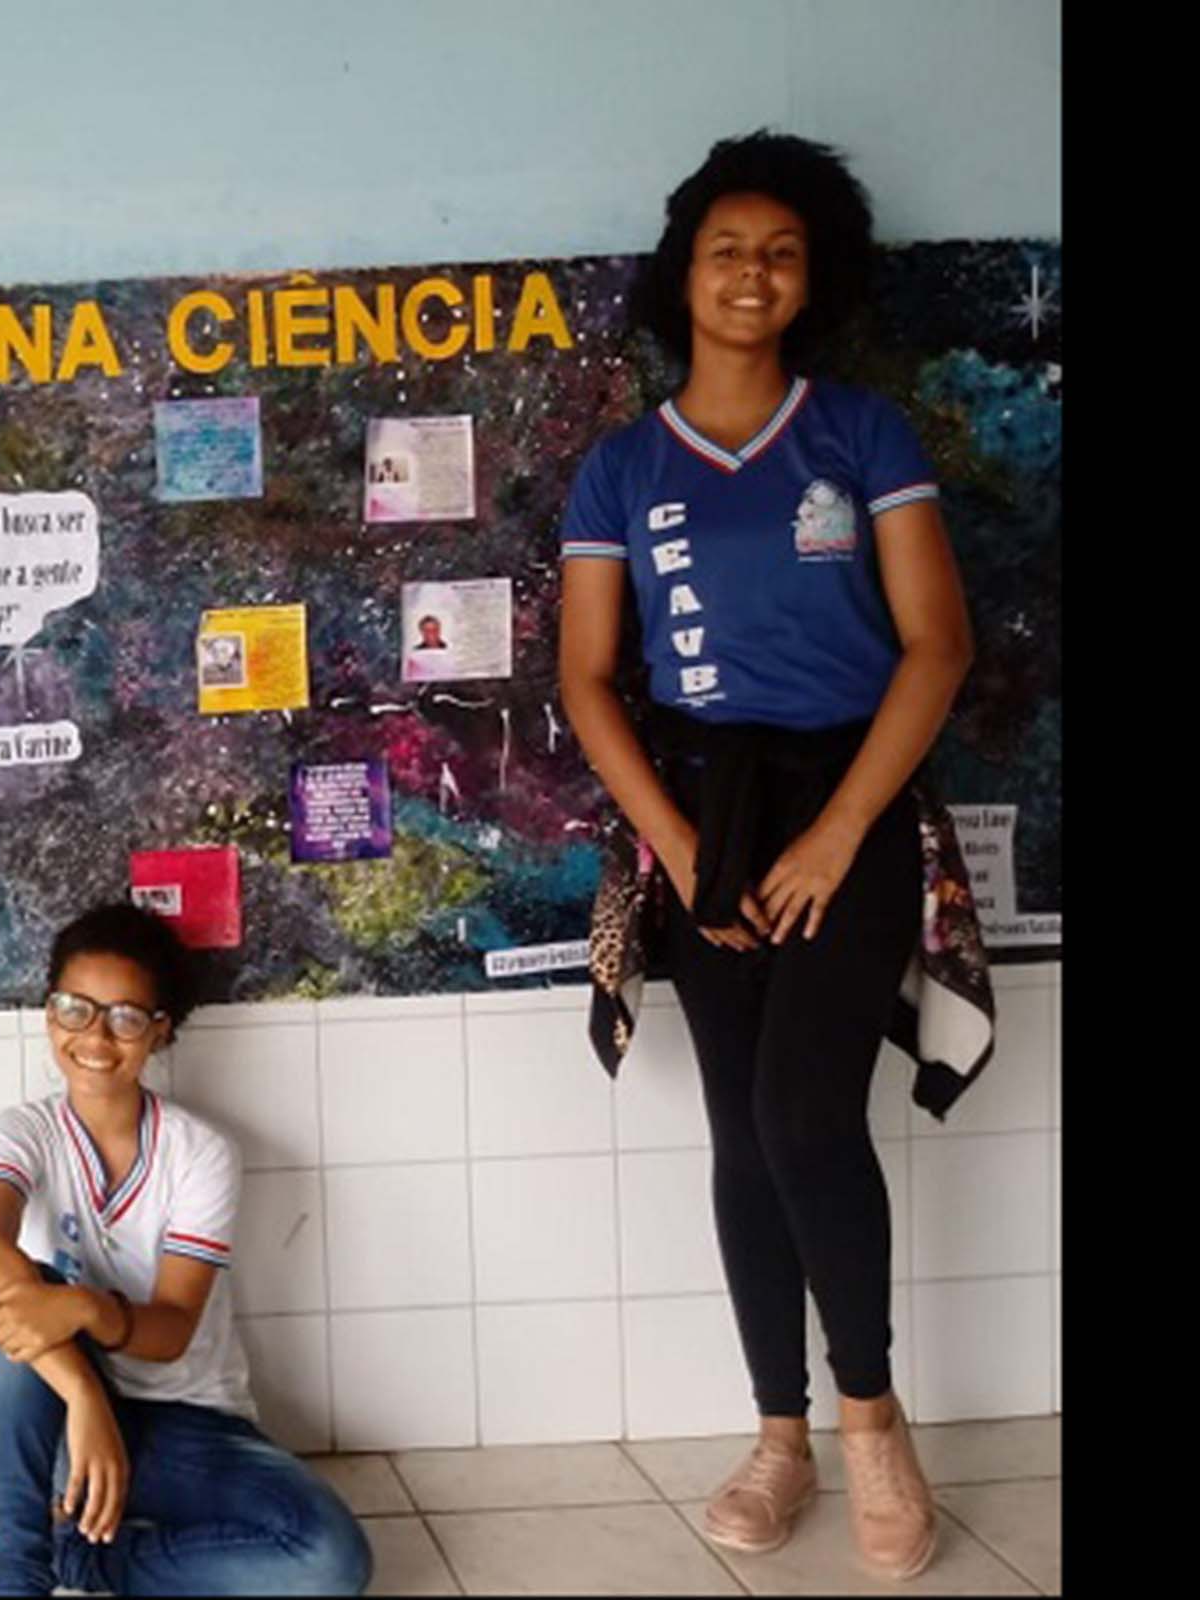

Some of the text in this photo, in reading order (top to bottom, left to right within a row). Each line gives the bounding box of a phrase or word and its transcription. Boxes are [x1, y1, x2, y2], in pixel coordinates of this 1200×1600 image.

[166, 270, 574, 374] CIÊNCIA
[2, 506, 51, 536] busca
[56, 512, 86, 532] ser
[17, 565, 27, 586] a
[32, 560, 83, 588] gente
[648, 502, 718, 695] CEAVB
